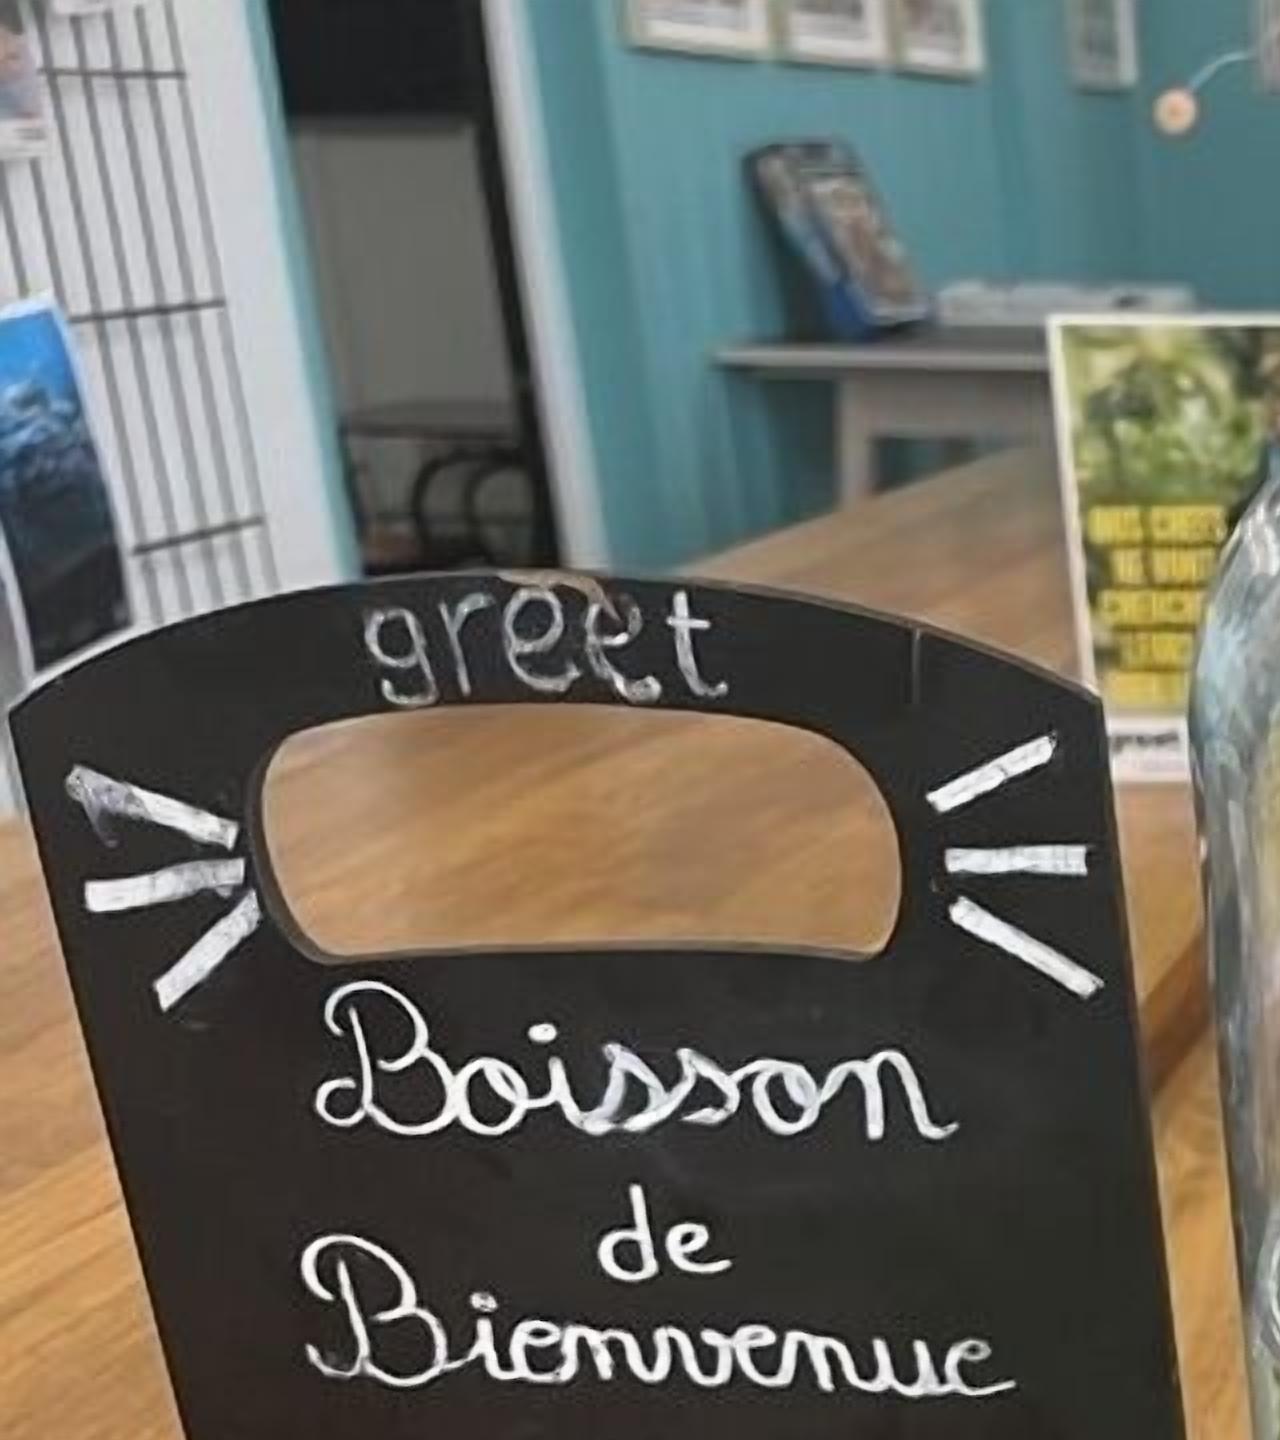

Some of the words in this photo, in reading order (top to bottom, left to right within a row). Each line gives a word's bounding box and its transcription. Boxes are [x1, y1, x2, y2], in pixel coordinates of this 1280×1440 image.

[363, 586, 729, 706] greet
[314, 980, 960, 1140] Boisson
[597, 1183, 734, 1282] de
[300, 1234, 1017, 1397] Bienvenue
